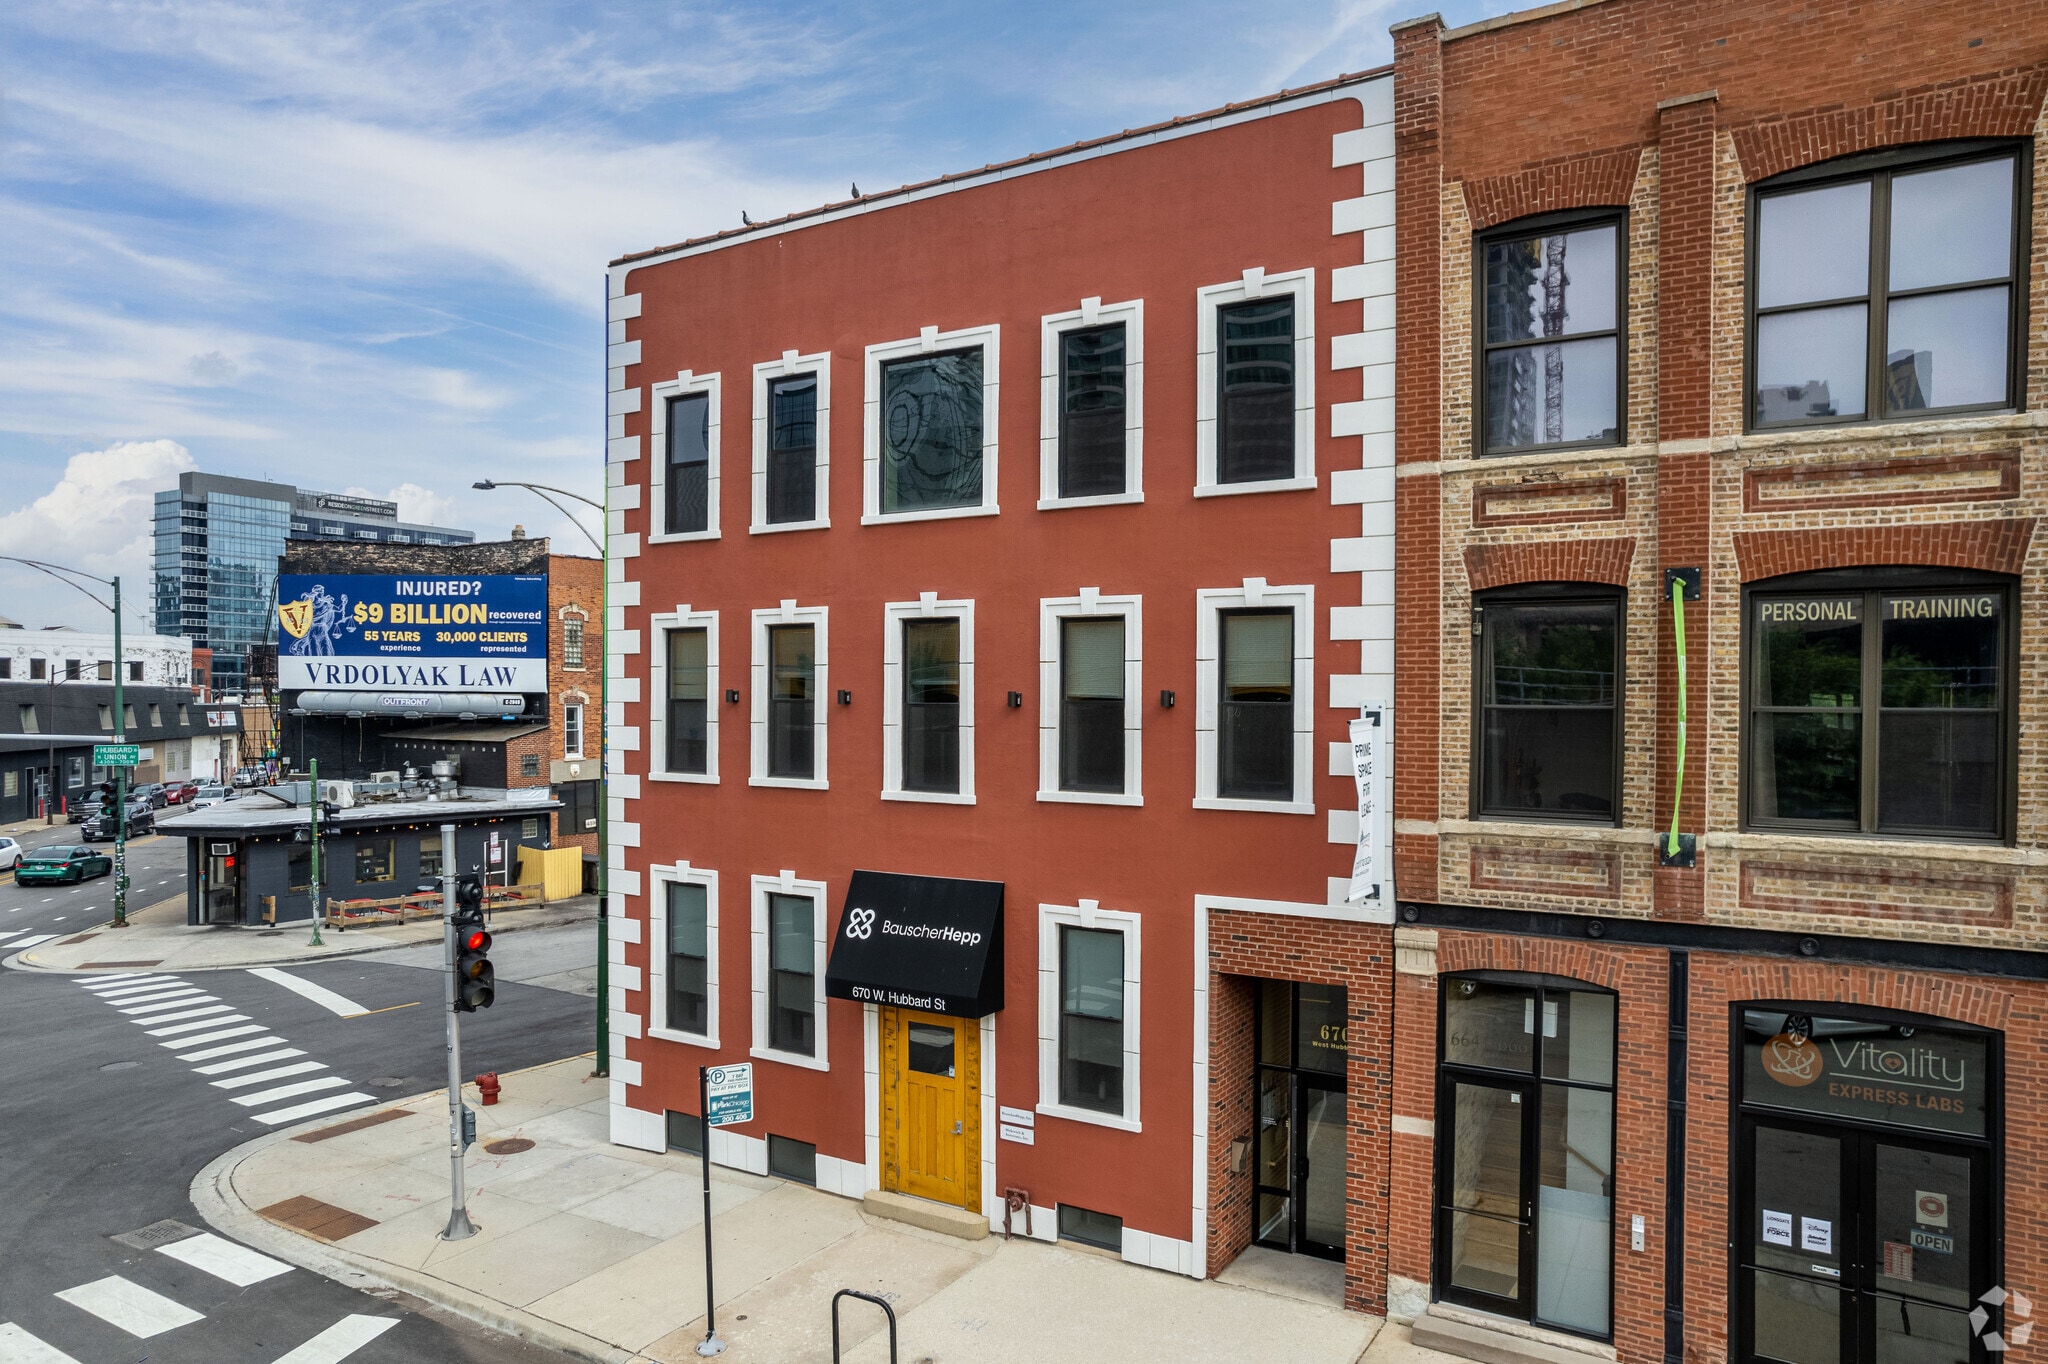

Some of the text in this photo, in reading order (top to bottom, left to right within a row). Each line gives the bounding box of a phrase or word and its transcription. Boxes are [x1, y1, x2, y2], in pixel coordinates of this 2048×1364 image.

[396, 581, 482, 596] INJURED?
[353, 601, 541, 625] $9 BILLION recovered
[1761, 597, 1993, 622] PERSONAL TRAINING
[364, 631, 528, 643] 55 YEARS 30,000 CLIENTS
[380, 644, 527, 653] experience represented
[305, 662, 518, 686] VRDOLYAK LAW
[383, 697, 429, 706] OUTFRONT
[1354, 742, 1372, 758] PRIME
[882, 920, 981, 946] BauscherHepp
[852, 986, 946, 1011] 670 W. Hubbard St
[1829, 1037, 1965, 1092] Vitality
[714, 1073, 722, 1081] P
[1829, 1082, 1965, 1114] EXPRESS LABS
[1766, 1228, 1790, 1238] FORCE
[1805, 1223, 1829, 1234] Disney
[1915, 1233, 1951, 1252] OPEN
